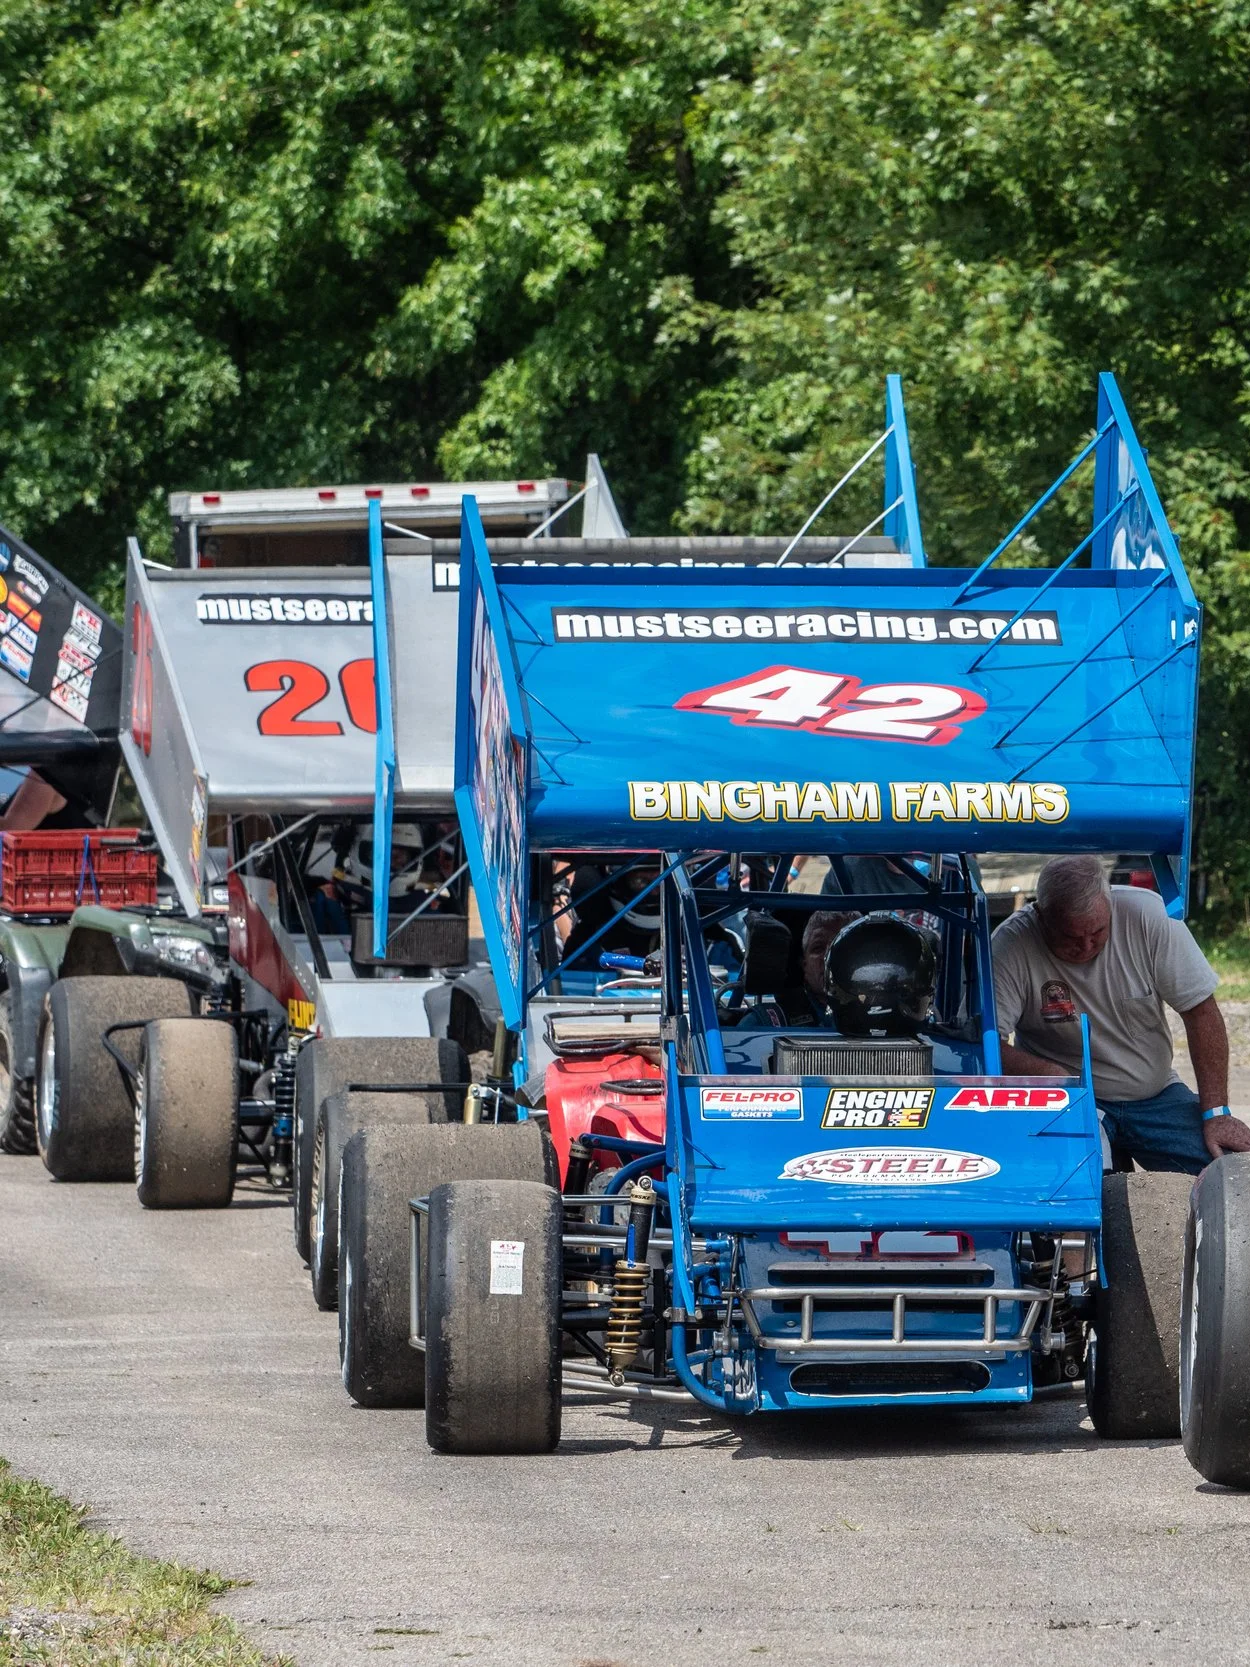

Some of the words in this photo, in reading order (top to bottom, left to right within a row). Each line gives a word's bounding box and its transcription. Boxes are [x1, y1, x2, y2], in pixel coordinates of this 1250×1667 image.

[555, 612, 1059, 642] mustseeracing.com
[690, 667, 978, 743] 42
[629, 782, 881, 821] BINGHAM
[892, 782, 1069, 823] FARMS
[705, 1092, 796, 1103] FEL-PRO
[830, 1090, 932, 1109] ENGINE
[950, 1089, 1067, 1106] ARP
[825, 1109, 886, 1127] PRO
[825, 1157, 984, 1174] STEELE
